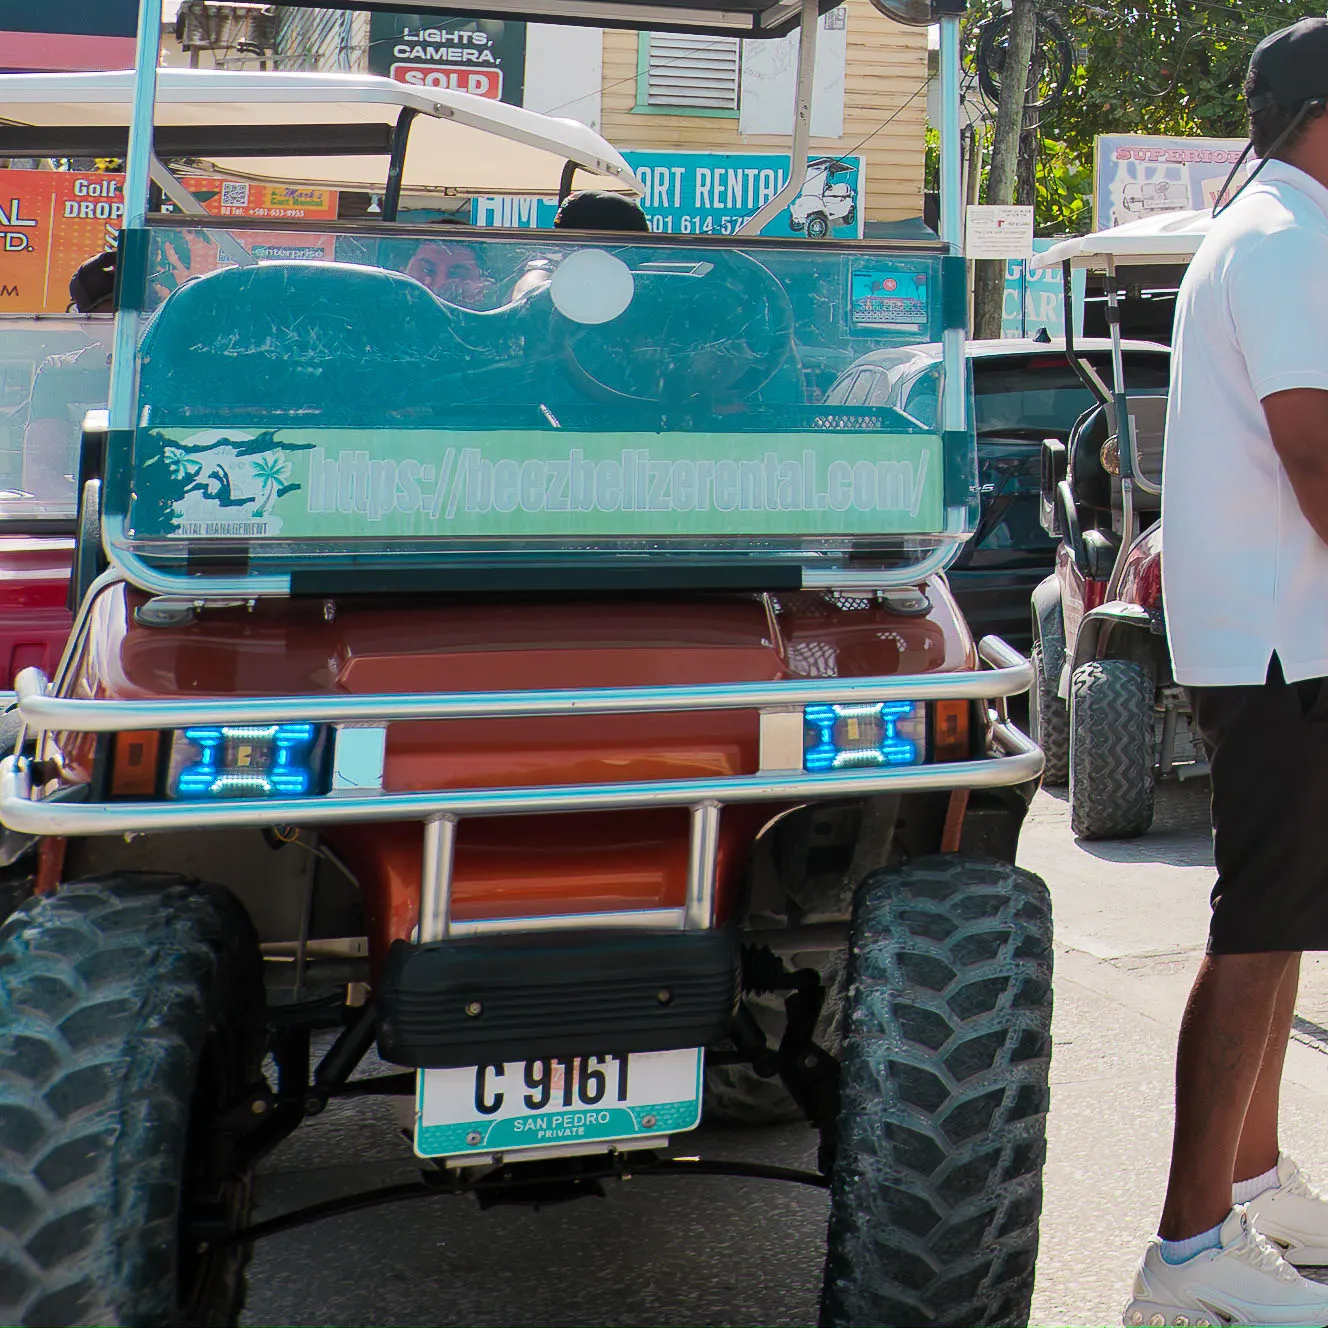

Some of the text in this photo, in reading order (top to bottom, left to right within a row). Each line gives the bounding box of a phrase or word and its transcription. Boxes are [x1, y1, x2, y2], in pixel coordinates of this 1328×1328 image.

[393, 45, 502, 65] CAMERA,
[404, 71, 490, 95] SOLD
[74, 179, 118, 197] Golf
[636, 166, 687, 209] ART
[474, 1049, 629, 1115] C 9161
[513, 1111, 610, 1132] SAN PEDRO
[537, 1126, 585, 1139] PRIVATE
